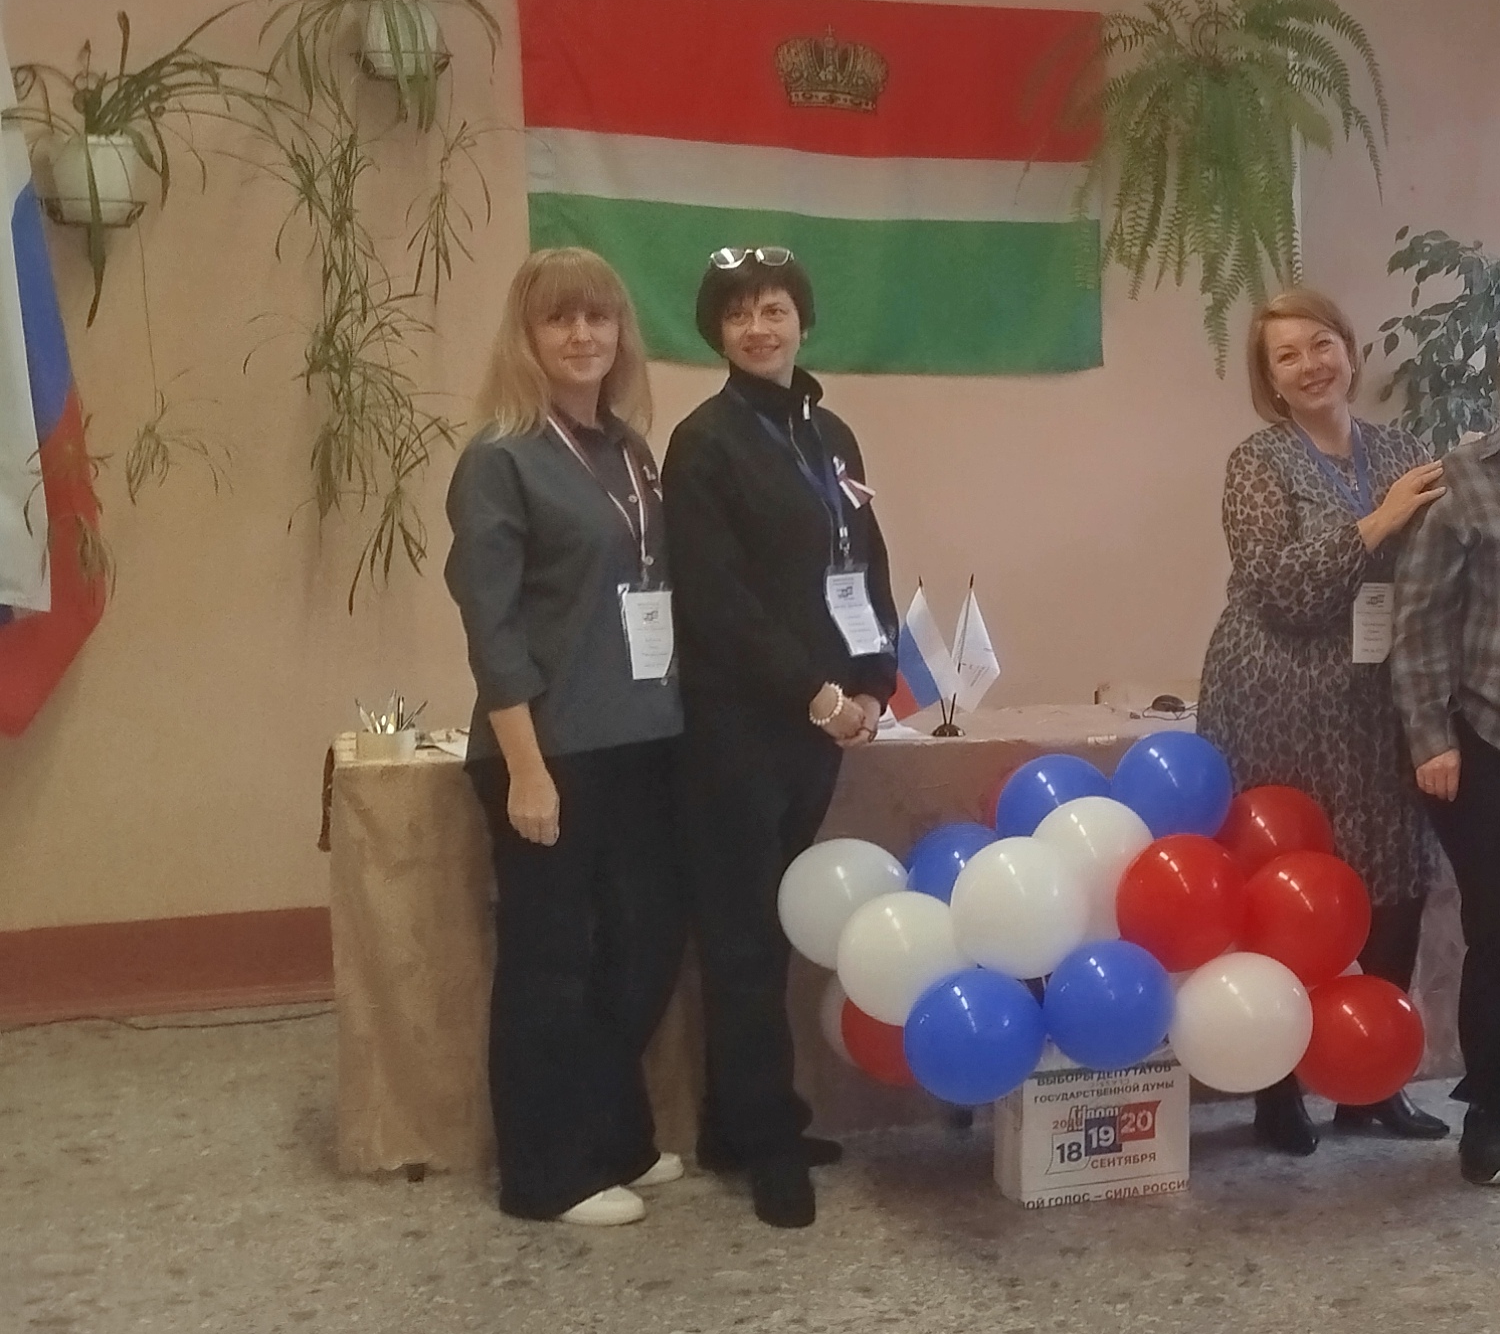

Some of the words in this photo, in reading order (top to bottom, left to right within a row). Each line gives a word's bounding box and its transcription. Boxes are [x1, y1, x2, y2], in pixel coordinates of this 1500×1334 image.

[1037, 1071, 1093, 1087] ВЫБОРЫ
[1094, 1064, 1172, 1081] ДЕПУТАТОВ
[1034, 1083, 1140, 1104] ГОСУДАРСТВЕННОЙ
[1141, 1080, 1175, 1093] ДУМЫ
[1120, 1108, 1153, 1135] 20
[1087, 1125, 1115, 1149] 19
[1056, 1141, 1083, 1164] 18
[1090, 1152, 1157, 1169] СЕНТЯБРЯ
[1048, 1192, 1091, 1208] ГОЛОС
[1105, 1186, 1140, 1200] СИЛА
